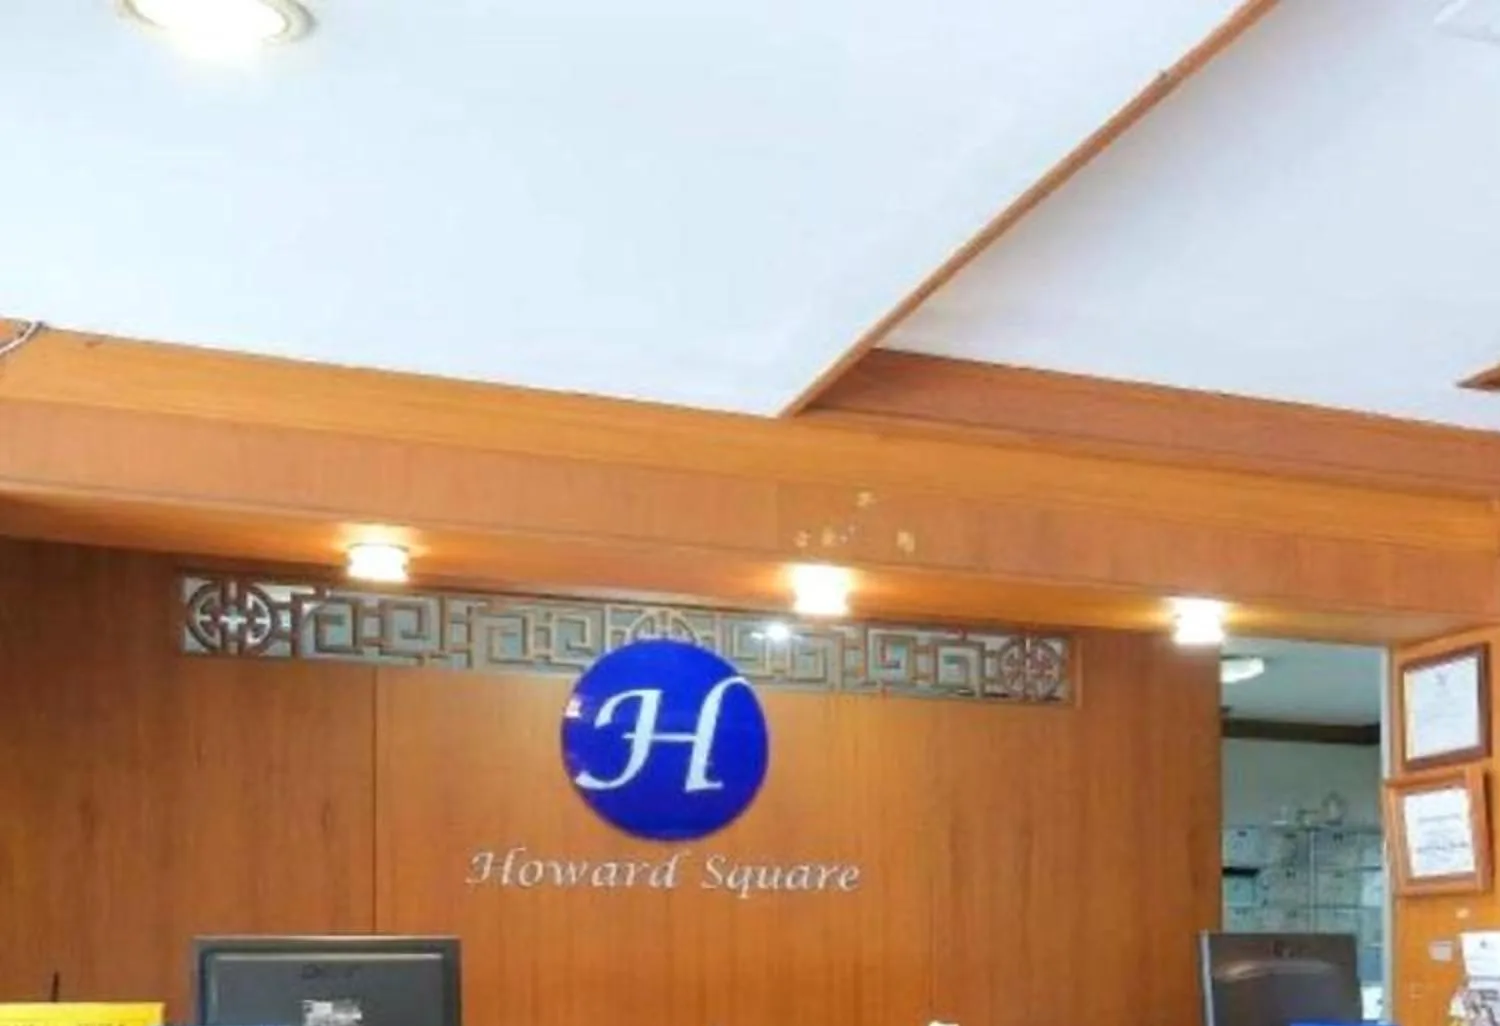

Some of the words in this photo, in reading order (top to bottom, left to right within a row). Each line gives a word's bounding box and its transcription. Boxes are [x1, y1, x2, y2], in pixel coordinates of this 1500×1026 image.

[575, 676, 748, 793] H
[465, 846, 690, 888] Howard
[700, 855, 860, 898] Square
